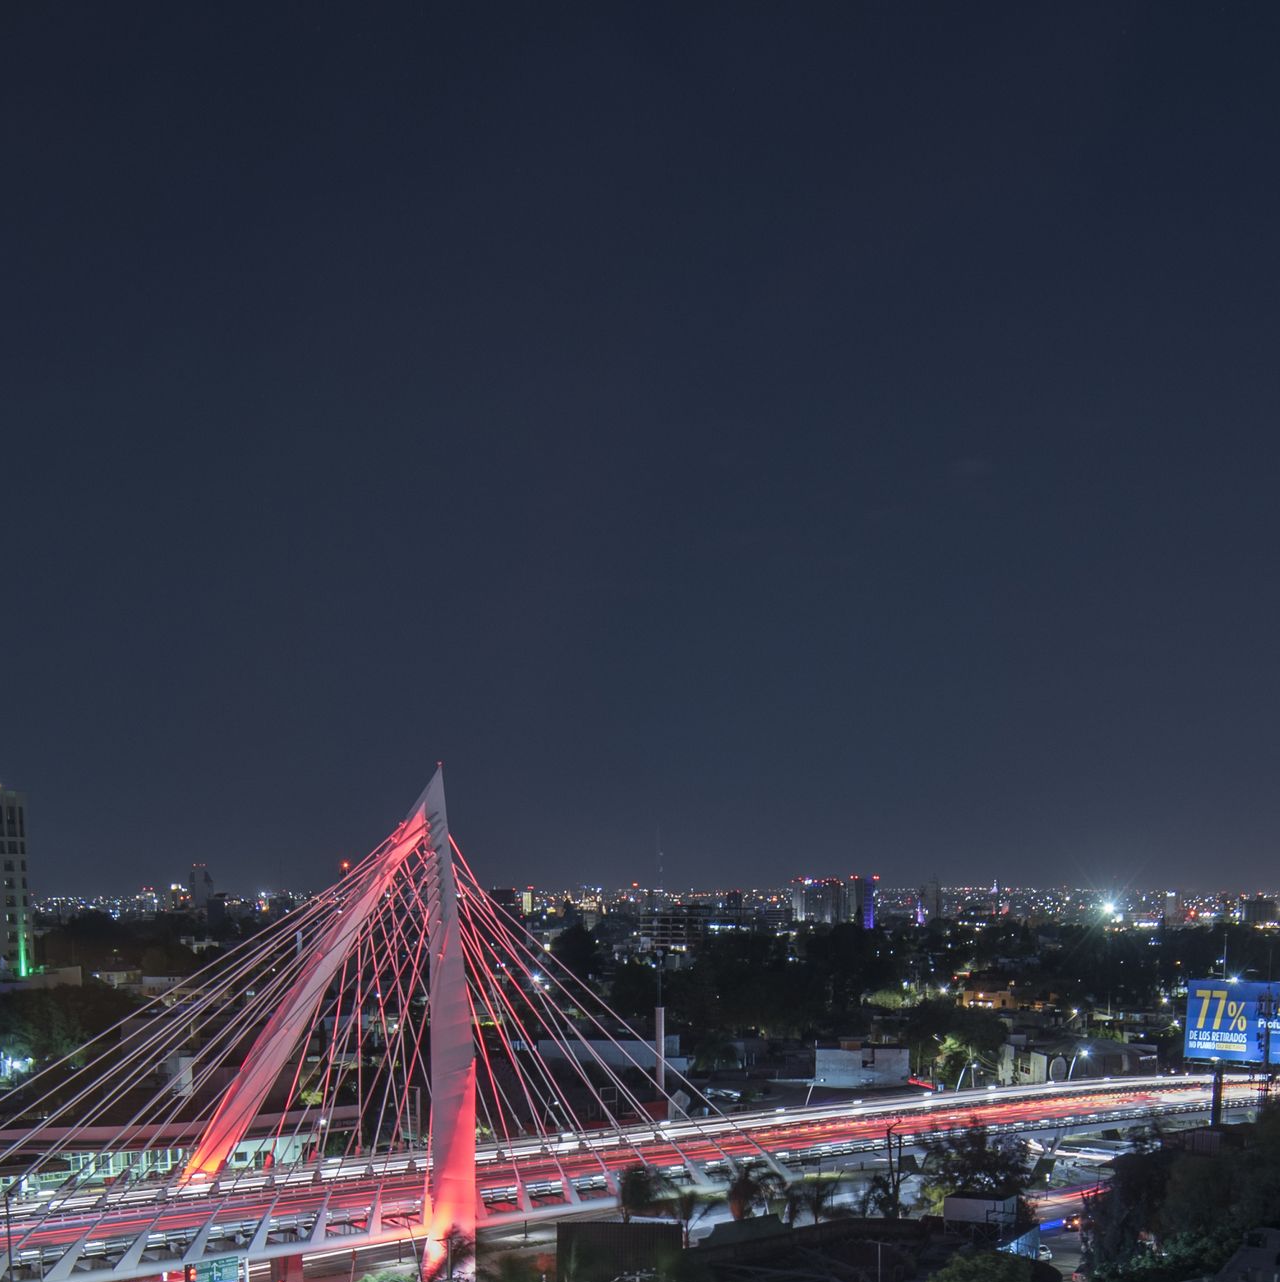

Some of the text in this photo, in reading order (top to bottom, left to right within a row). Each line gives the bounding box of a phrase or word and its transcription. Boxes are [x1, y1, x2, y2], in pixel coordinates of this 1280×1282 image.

[1195, 989, 1247, 1031] 77%
[1189, 1030, 1248, 1043] DE LOS RETIRADOS
